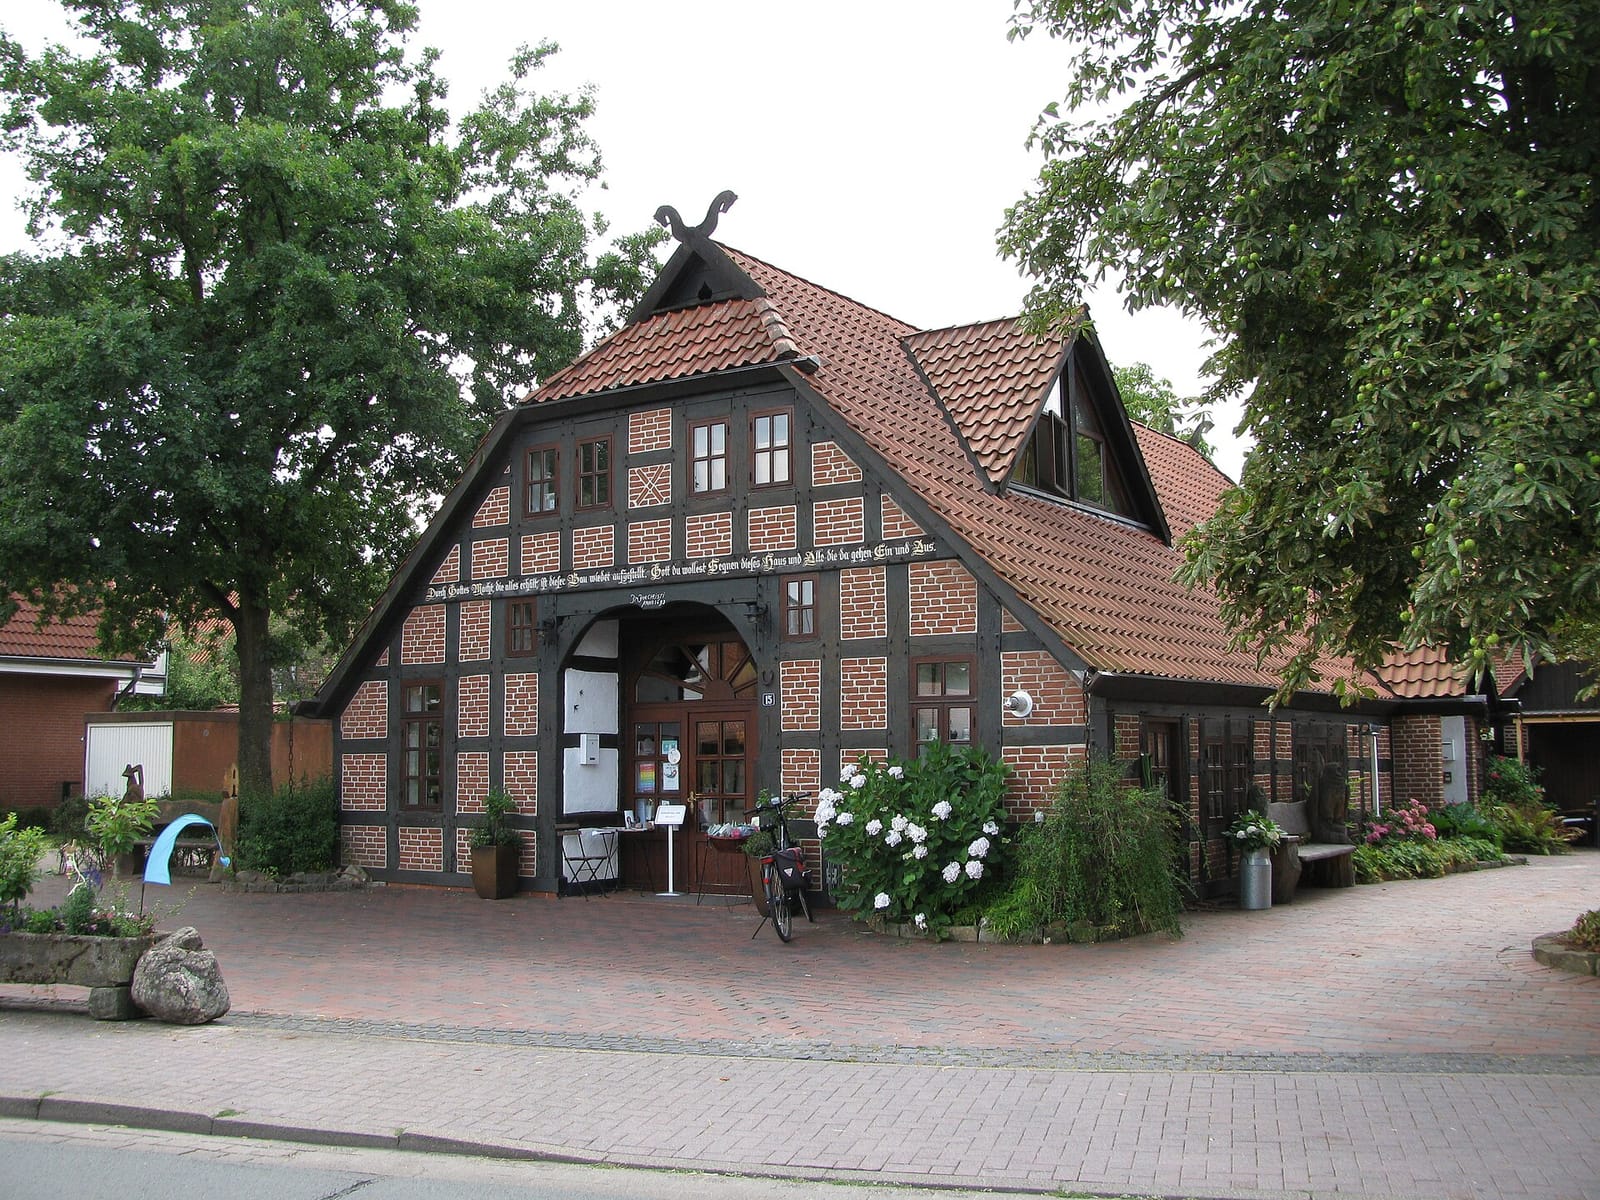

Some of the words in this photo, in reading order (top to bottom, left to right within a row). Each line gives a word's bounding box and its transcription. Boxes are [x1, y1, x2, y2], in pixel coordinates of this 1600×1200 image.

[448, 584, 469, 599] Gottes
[495, 580, 504, 592] die
[505, 579, 519, 591] alles
[567, 572, 588, 587] Bau
[589, 570, 610, 584] wieder
[650, 563, 670, 580] Gott
[671, 563, 681, 576] du
[707, 558, 739, 575] Segnen
[762, 552, 787, 571] Haus
[788, 553, 802, 565] und
[803, 549, 824, 566] Alle
[826, 549, 838, 561] die
[839, 548, 849, 561] da
[894, 542, 910, 555] und
[765, 695, 773, 705] 15
